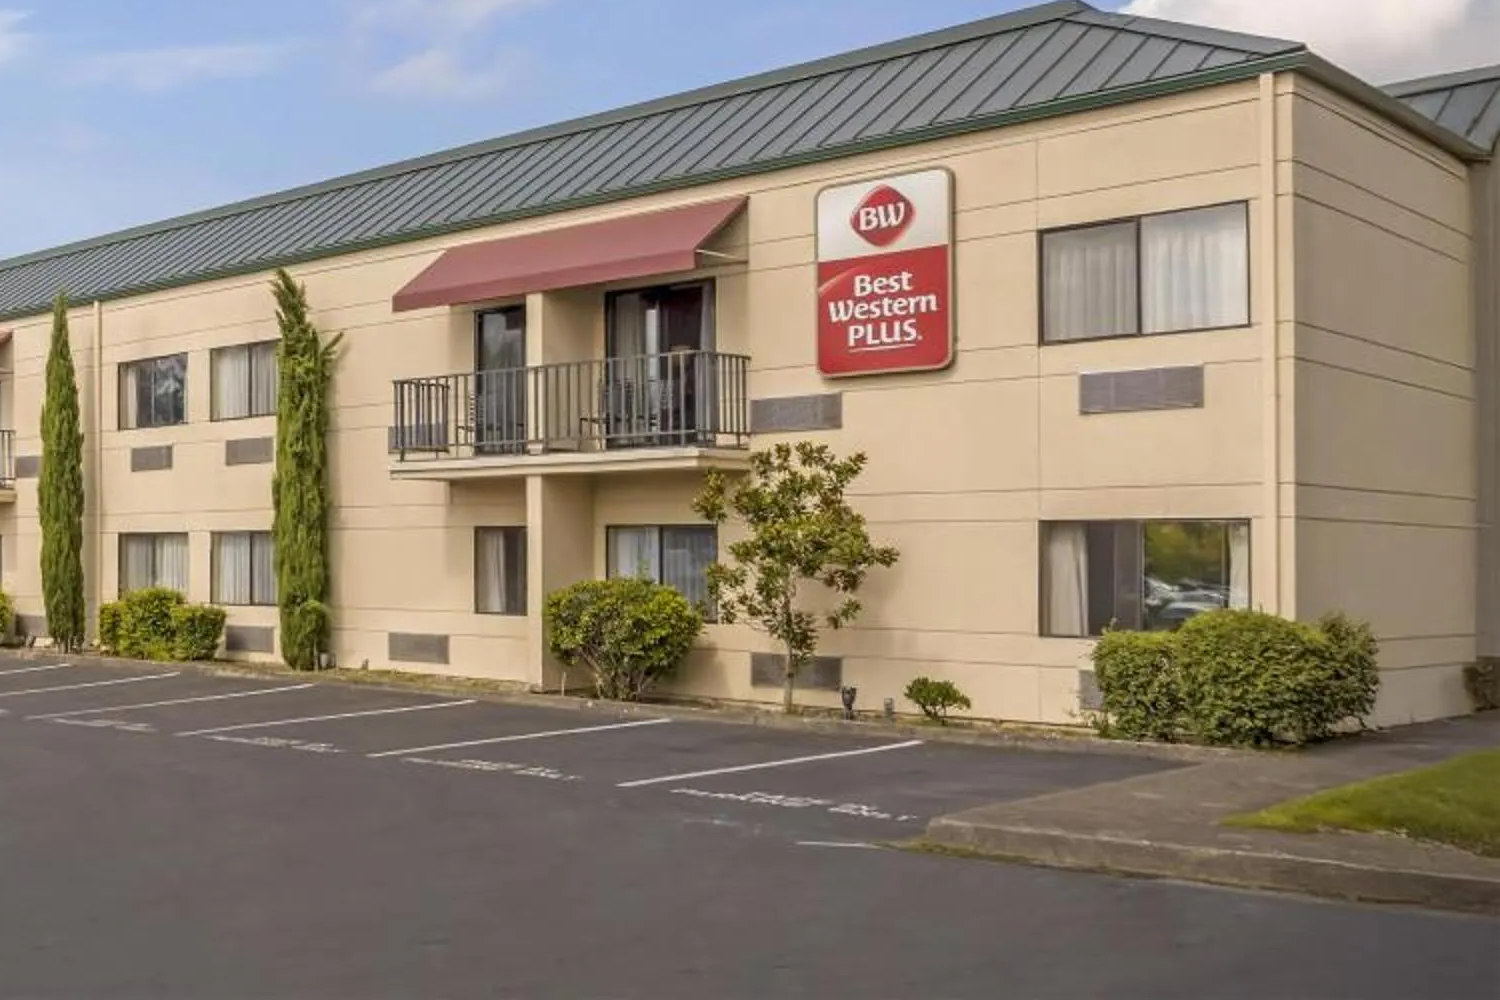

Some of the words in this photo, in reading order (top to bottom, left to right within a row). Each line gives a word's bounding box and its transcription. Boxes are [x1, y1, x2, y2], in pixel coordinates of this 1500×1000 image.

[858, 201, 905, 231] BW
[854, 271, 914, 297] Best
[828, 293, 938, 323] Western
